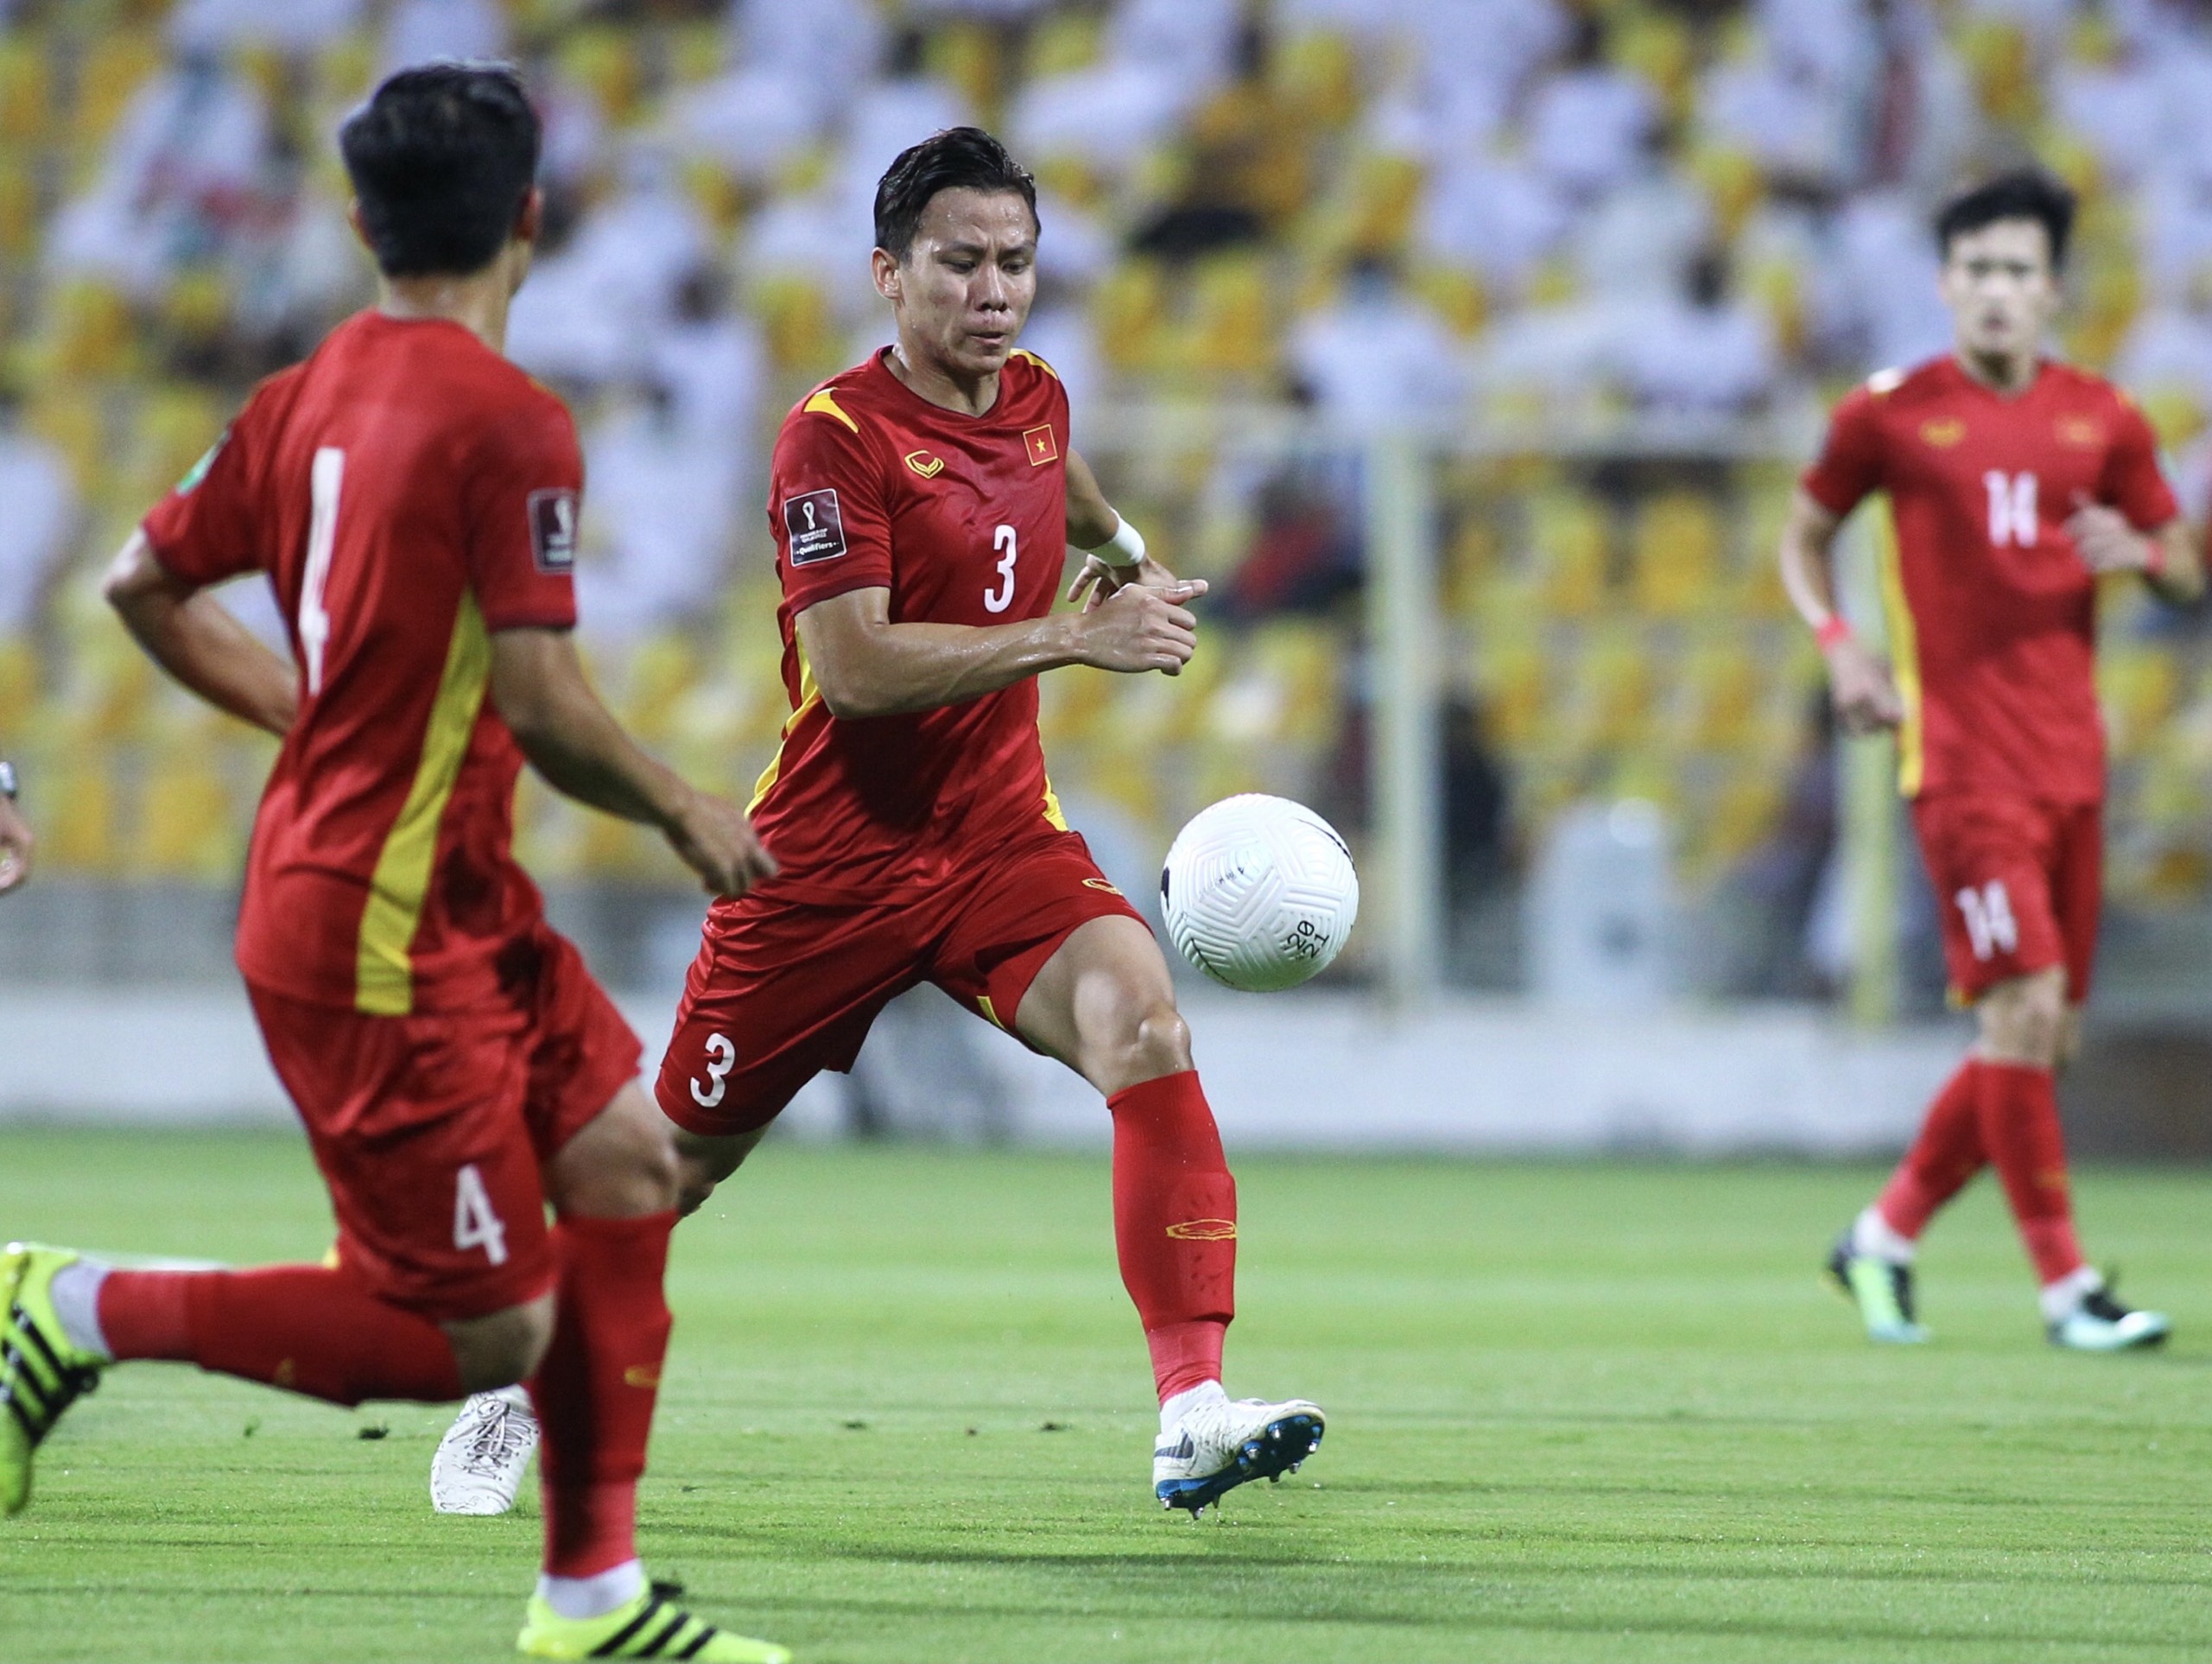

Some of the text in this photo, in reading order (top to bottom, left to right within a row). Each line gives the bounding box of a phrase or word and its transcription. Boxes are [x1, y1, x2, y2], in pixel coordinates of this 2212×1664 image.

[1983, 468, 2038, 549] 14
[984, 524, 1017, 613] 3
[1287, 919, 1315, 950] 20
[1302, 934, 1330, 959] 21
[1955, 880, 2018, 961] 14
[690, 1032, 735, 1108] 3
[453, 1163, 508, 1267] 4
